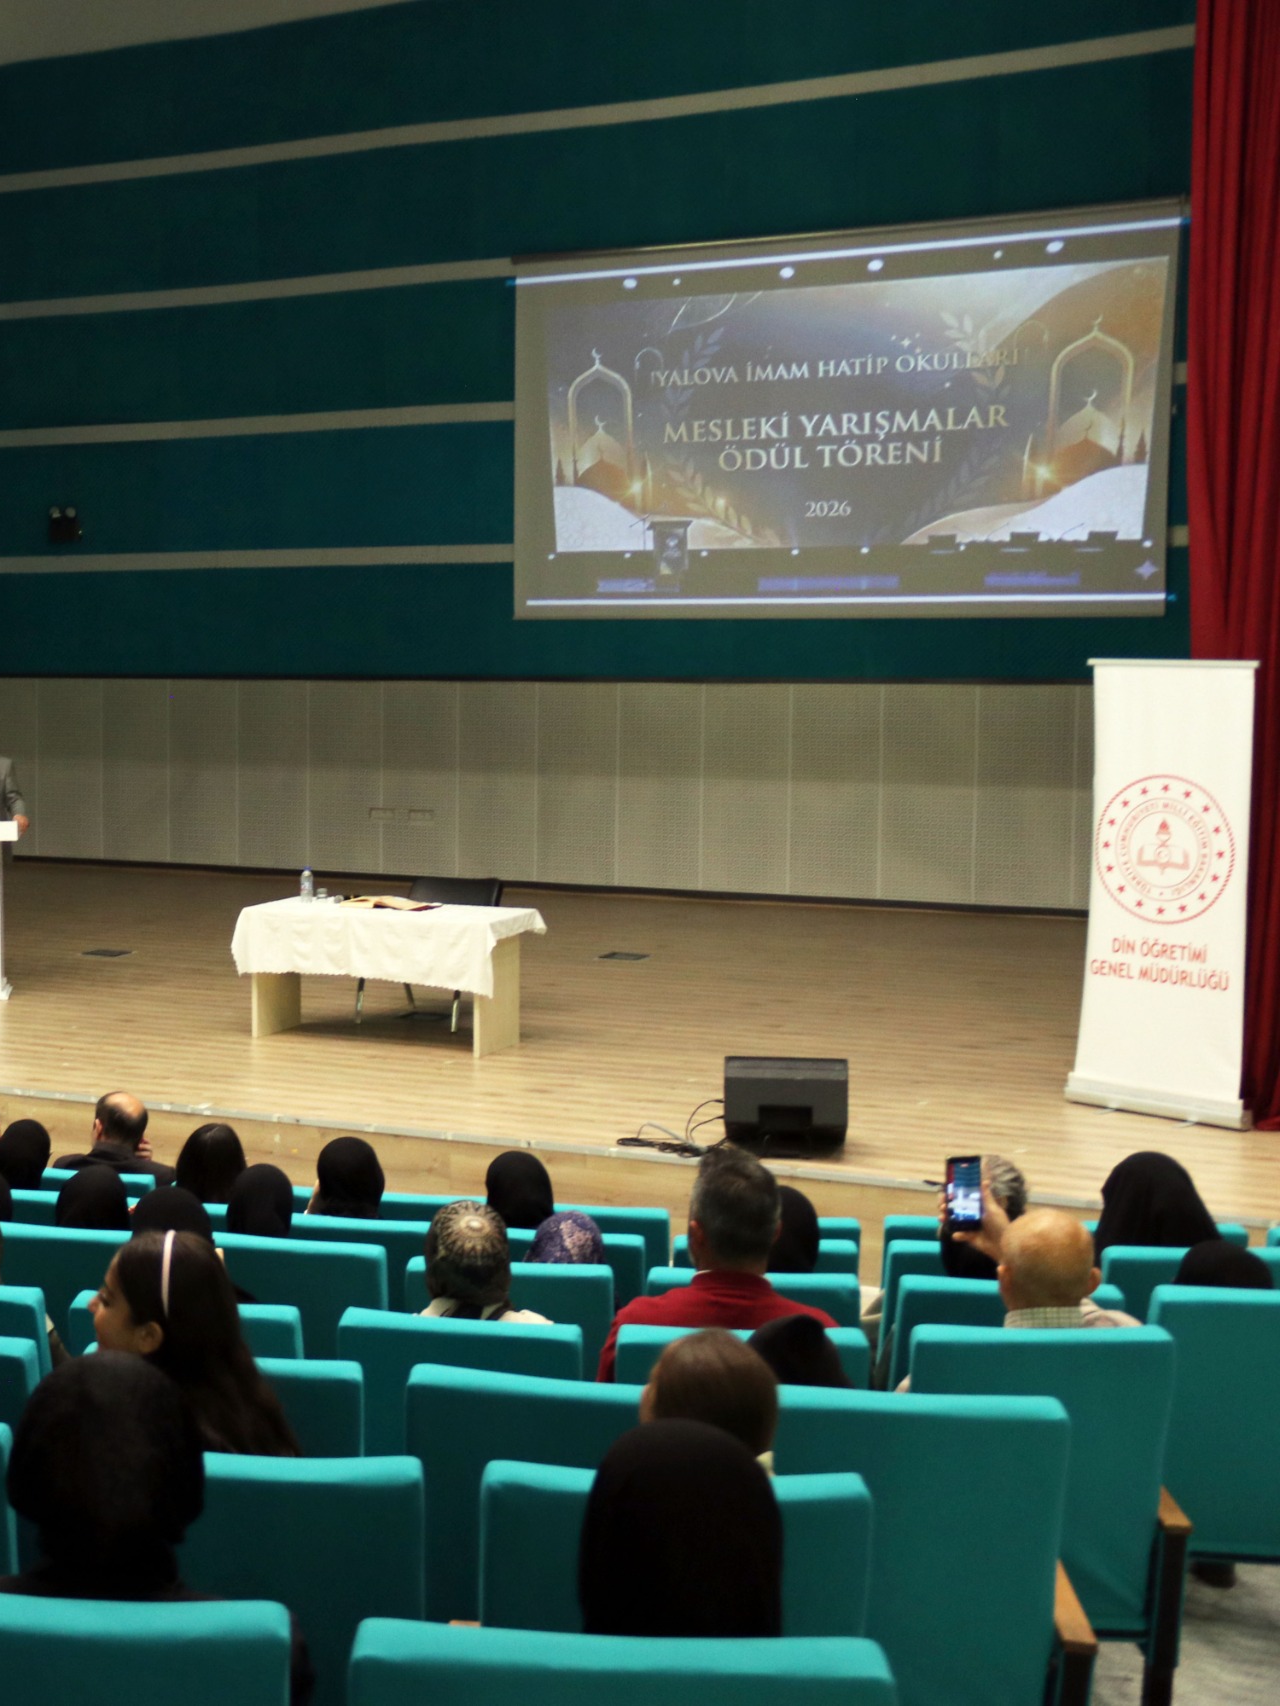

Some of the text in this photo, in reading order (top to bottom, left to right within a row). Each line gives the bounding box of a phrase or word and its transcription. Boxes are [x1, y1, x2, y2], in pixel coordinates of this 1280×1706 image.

[655, 347, 1021, 387] YALOVA İMAM HATİP OKULLARI
[663, 404, 1010, 444] MESLEKİ YARIŞMALAR
[718, 435, 944, 472] ÖDÜL TÖRENİ
[805, 500, 852, 518] 2026
[1112, 935, 1209, 964] DİN ÖĞRETİMİ
[1090, 959, 1230, 991] GENEL MÜDÜRLÜĞÜ
